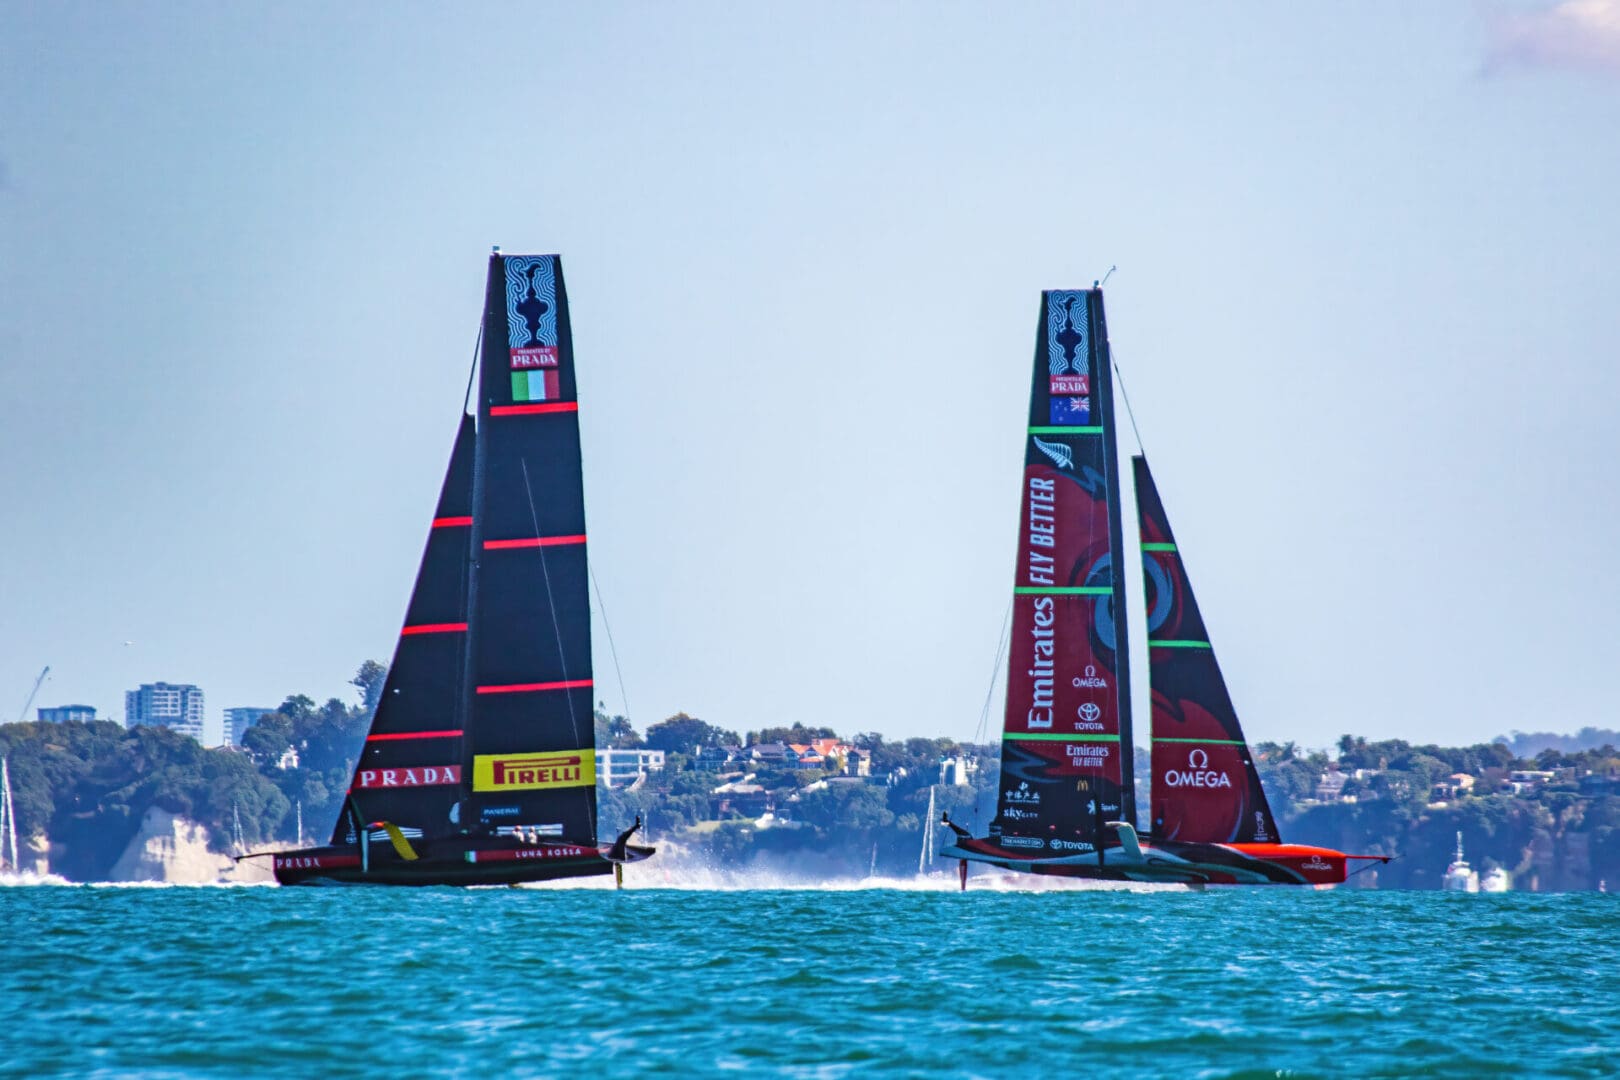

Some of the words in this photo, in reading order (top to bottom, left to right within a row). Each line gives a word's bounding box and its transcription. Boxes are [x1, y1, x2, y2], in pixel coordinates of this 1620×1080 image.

[512, 354, 556, 366] PRADA
[1051, 382, 1088, 392] PRADA
[1030, 477, 1055, 548] BETTER
[1030, 552, 1055, 585] FLY
[1027, 597, 1055, 730] Emirates
[1072, 677, 1107, 688] OMEGA
[1074, 722, 1105, 731] TOYOTA
[1066, 744, 1109, 757] Emirates
[493, 756, 581, 785] PIRELLI
[360, 767, 456, 787] PRADA
[1165, 770, 1231, 787] OMEGA
[1062, 841, 1094, 851] TOYOTA
[515, 850, 542, 858] LUNA
[547, 848, 581, 856] ROSSA
[276, 857, 320, 869] PRADA
